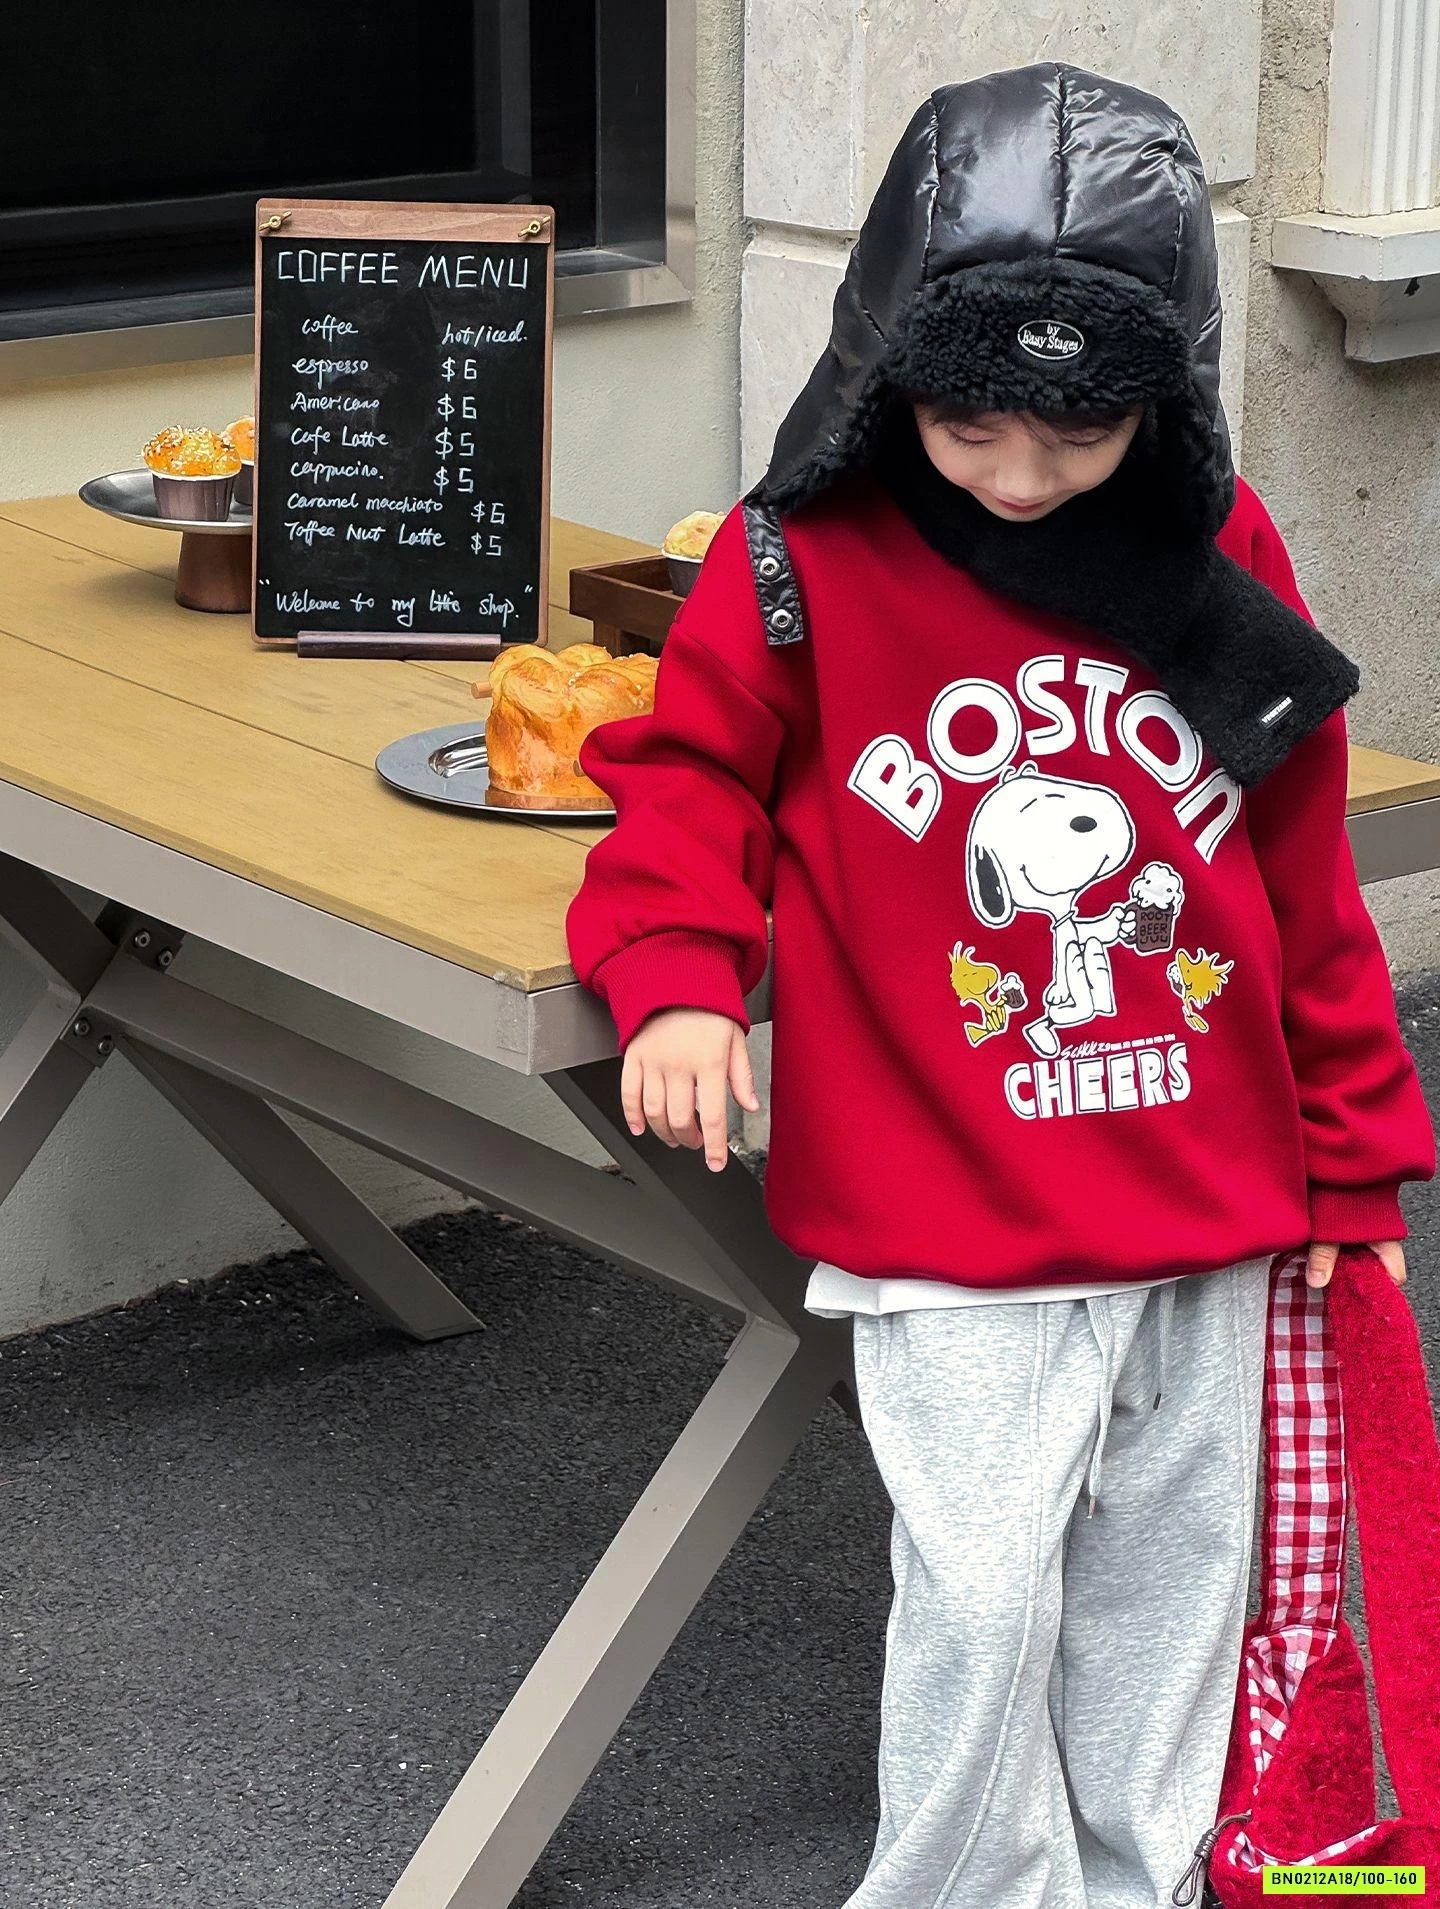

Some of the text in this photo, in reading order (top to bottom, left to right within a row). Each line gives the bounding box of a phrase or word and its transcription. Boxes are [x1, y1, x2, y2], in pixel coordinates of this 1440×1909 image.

[278, 250, 528, 289] COFFEE MENU
[302, 314, 358, 342] coffee
[1046, 323, 1061, 337] by
[292, 358, 368, 390] espresso
[291, 392, 380, 412] Americano
[342, 425, 389, 447] Latte
[287, 493, 359, 509] Caramel
[366, 496, 443, 514] macchiato
[284, 520, 335, 546] Toffee
[346, 524, 386, 541] Nut
[399, 523, 446, 546] Latte
[350, 593, 375, 612] to
[391, 597, 415, 627] my
[1140, 911, 1170, 921] ROOT
[1140, 923, 1168, 936] BEER
[1004, 1043, 1191, 1119] CHEERS
